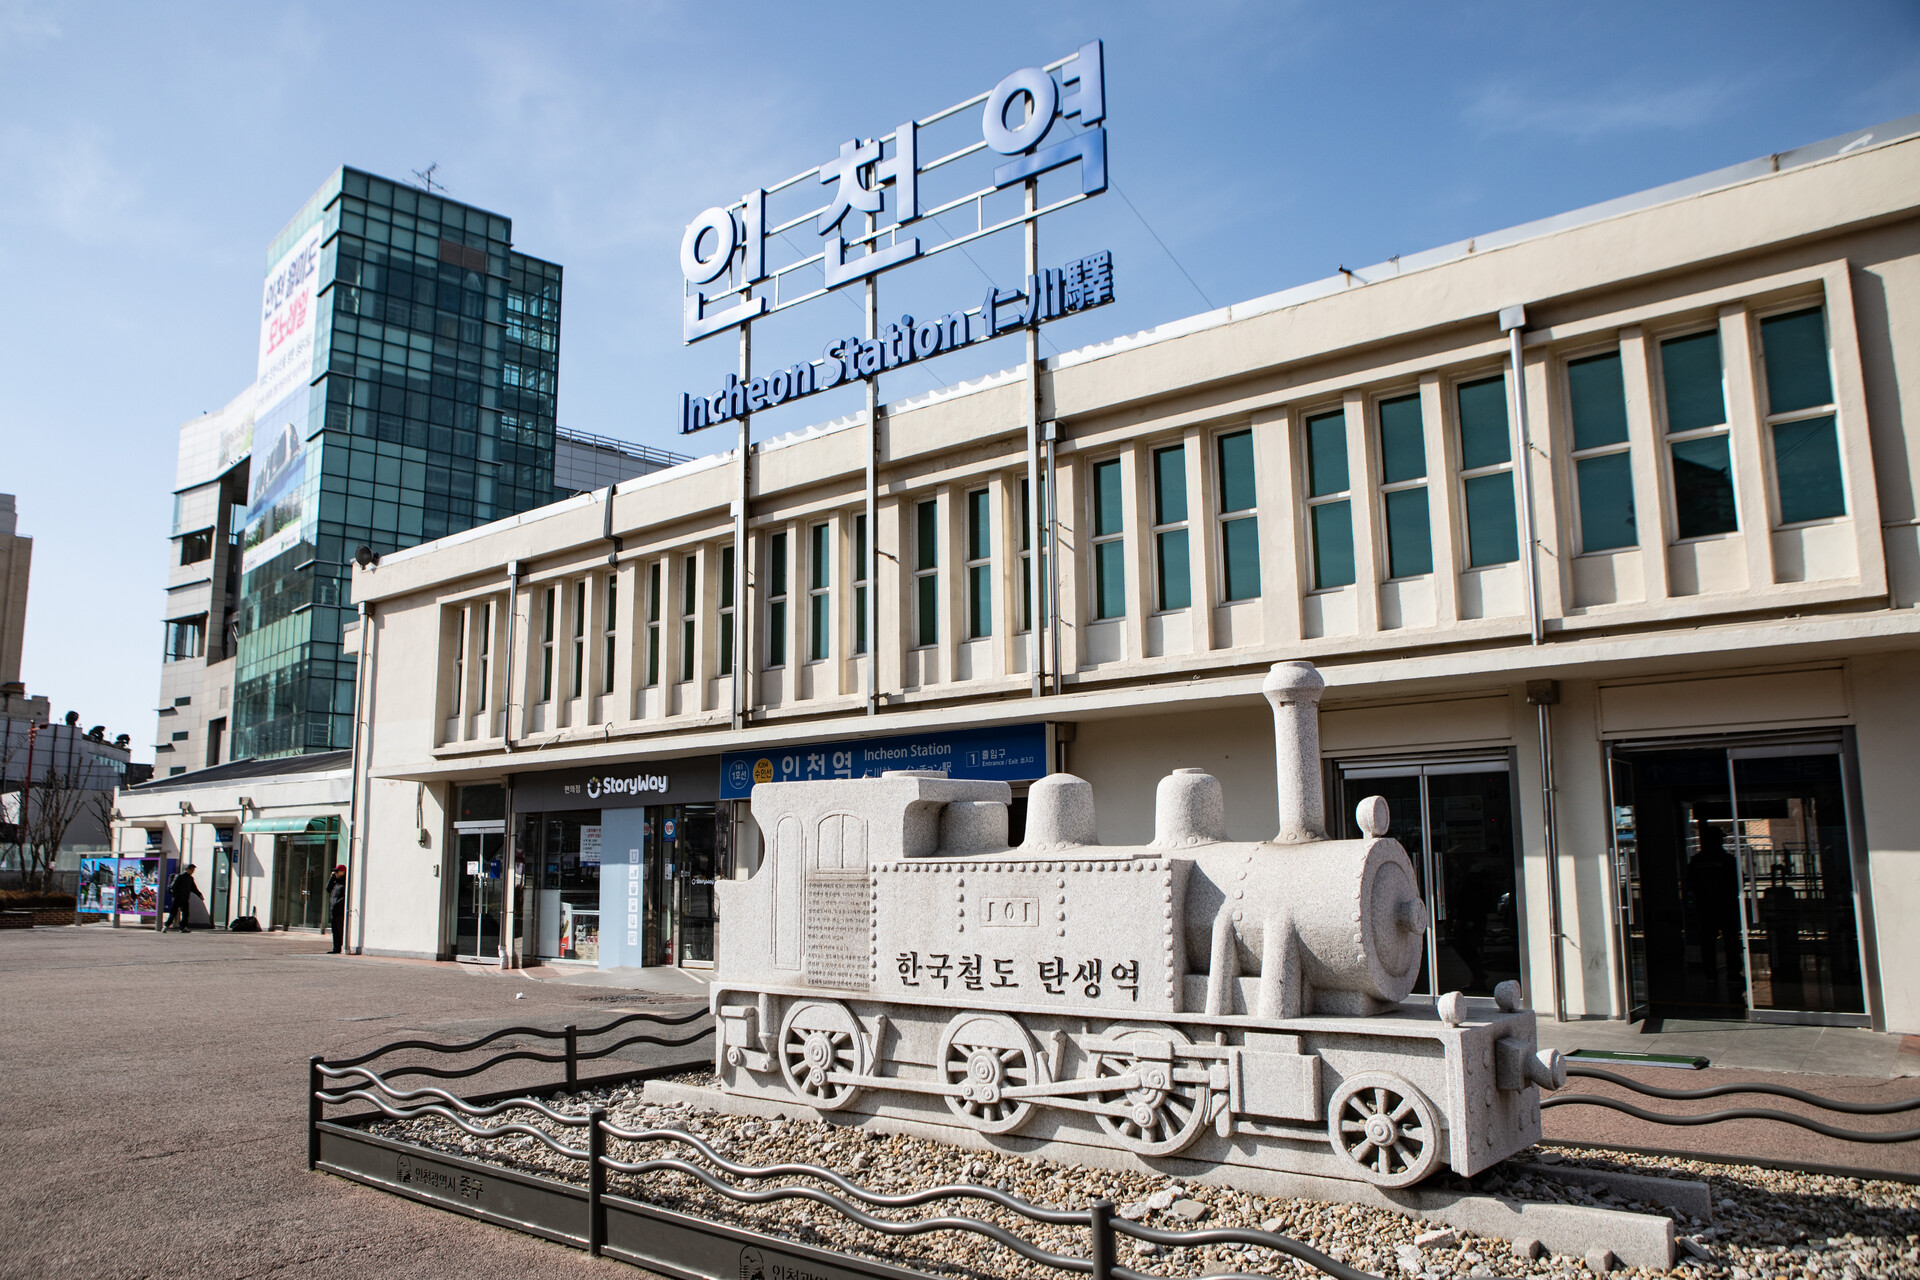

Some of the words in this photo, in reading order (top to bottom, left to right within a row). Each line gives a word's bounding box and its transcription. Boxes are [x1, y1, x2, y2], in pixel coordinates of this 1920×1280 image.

[680, 38, 1107, 344] 인천역
[267, 286, 310, 356] 모노레일
[678, 373, 816, 435] Incheon
[821, 311, 972, 391] Station
[979, 249, 1115, 337] 仁川驛
[864, 747, 908, 761] Incheon
[910, 742, 951, 758] Station
[970, 753, 976, 765] 1
[982, 748, 1006, 760] 출입구
[982, 759, 1005, 767] Entrance
[732, 770, 747, 781] 1호선
[755, 769, 772, 779] 수인선
[781, 751, 852, 782] 인천역
[564, 784, 581, 795] 편의점
[895, 950, 1020, 992] 한국철도
[1037, 955, 1141, 1003] 탄생역
[415, 1167, 456, 1193] 인천광역시
[459, 1175, 484, 1201] 중구
